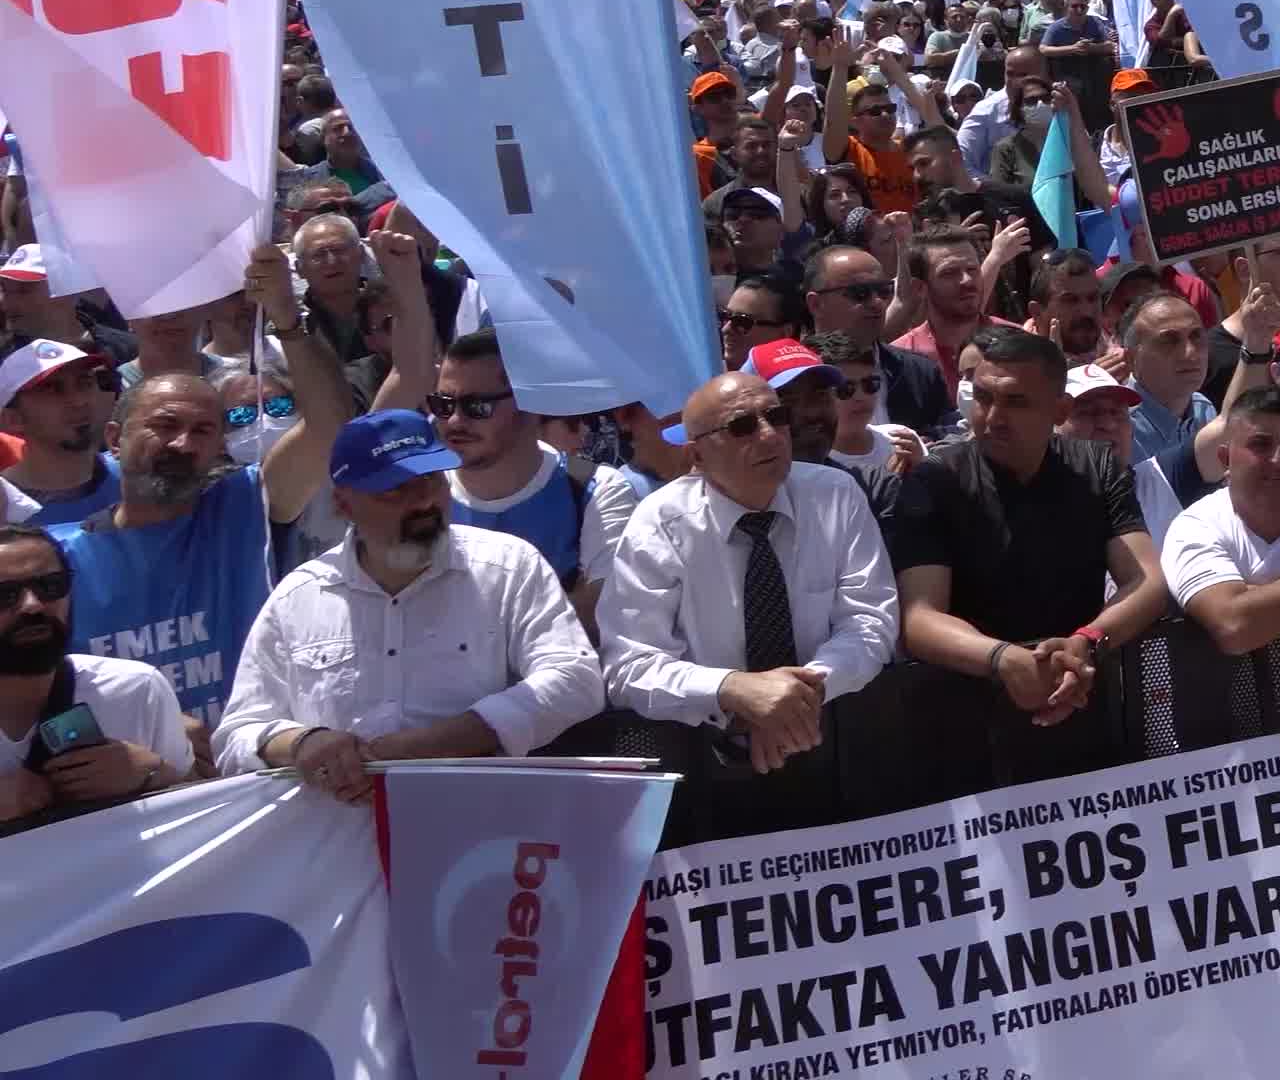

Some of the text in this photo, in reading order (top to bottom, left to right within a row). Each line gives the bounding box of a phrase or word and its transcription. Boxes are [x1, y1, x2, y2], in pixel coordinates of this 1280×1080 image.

[1199, 128, 1267, 157] SAĞLIK
[1186, 199, 1238, 224] SONA
[88, 611, 211, 659] EMEK
[718, 860, 753, 887] İLE
[760, 823, 957, 883] GEÇİNEMİYORUZ!
[963, 801, 1065, 841] İNSANCA
[1067, 778, 1179, 819] YAŞAMAK
[688, 854, 1006, 966] TENCERE,
[1022, 822, 1148, 900] BOŞ
[917, 905, 1157, 1011] YANGIN
[845, 1019, 987, 1071] YETMİYOR,
[991, 980, 1138, 1037] FATURALARI
